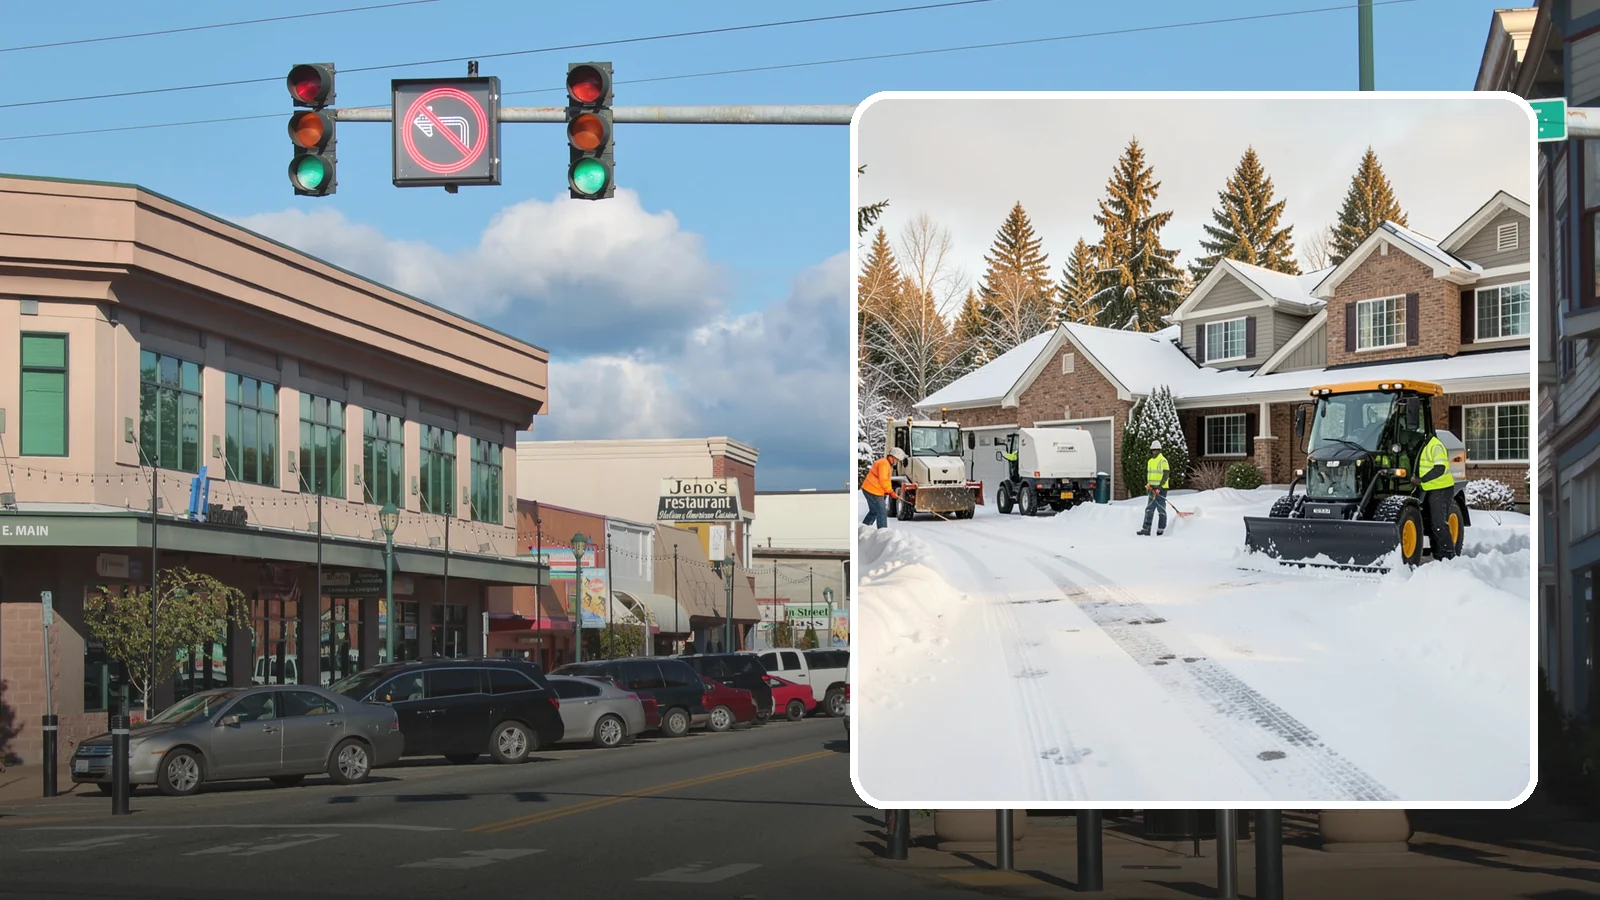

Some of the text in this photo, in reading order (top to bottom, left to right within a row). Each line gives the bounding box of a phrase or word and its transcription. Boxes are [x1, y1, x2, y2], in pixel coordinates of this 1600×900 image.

[669, 480, 728, 494] Jeno's
[665, 496, 731, 509] restaurant
[658, 510, 682, 520] Italian
[686, 510, 714, 519] American
[714, 509, 738, 519] Cuisine
[2, 525, 49, 536] E. MAIN
[797, 608, 828, 616] Street
